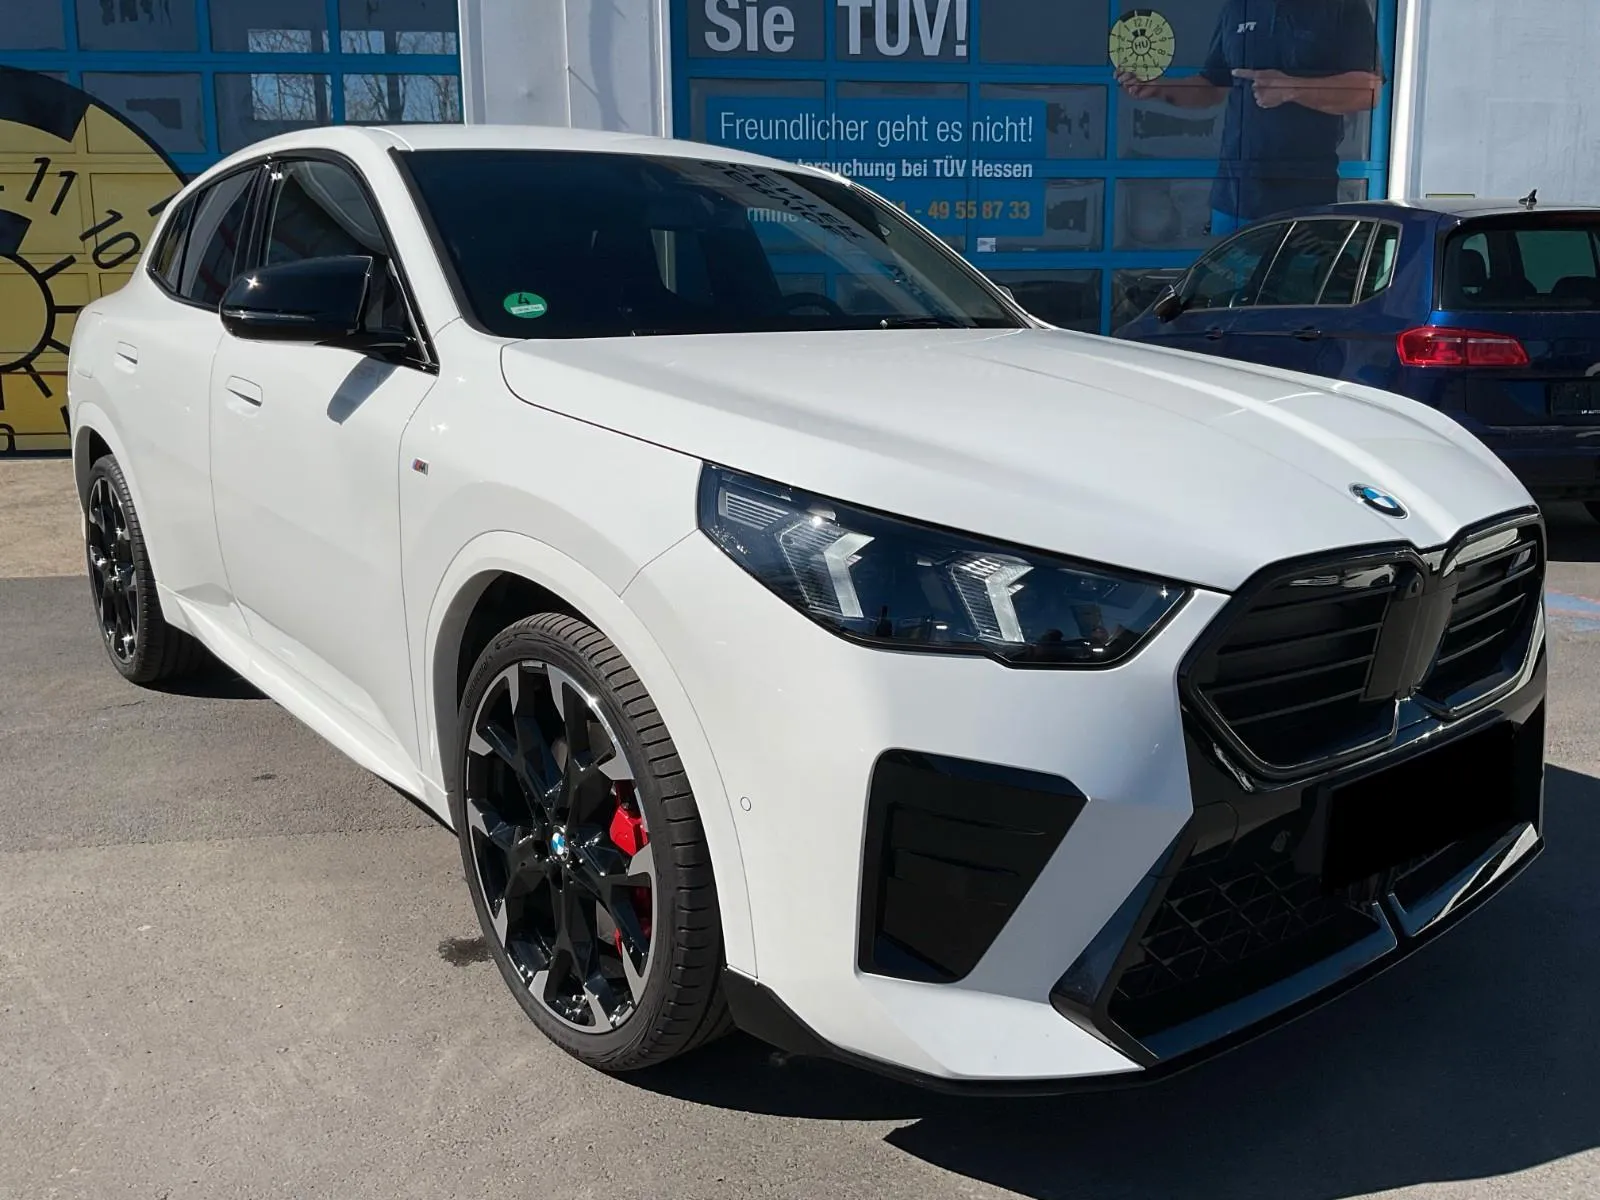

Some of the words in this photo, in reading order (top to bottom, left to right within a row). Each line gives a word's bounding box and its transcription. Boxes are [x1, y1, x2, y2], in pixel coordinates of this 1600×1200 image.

[704, 0, 795, 53] Sie
[1134, 40, 1149, 50] HU
[720, 111, 869, 142] Freundlicher
[877, 115, 928, 148] geht
[936, 121, 962, 142] es
[972, 115, 1033, 142] nicht!
[902, 159, 928, 178] bei
[933, 156, 967, 178] TÜV
[972, 159, 1033, 178] Hessen
[25, 156, 77, 216] 11
[928, 201, 950, 220] 49
[955, 201, 977, 219] 55
[983, 201, 1004, 219] 87
[1009, 201, 1030, 219] 33
[79, 209, 141, 270] 10
